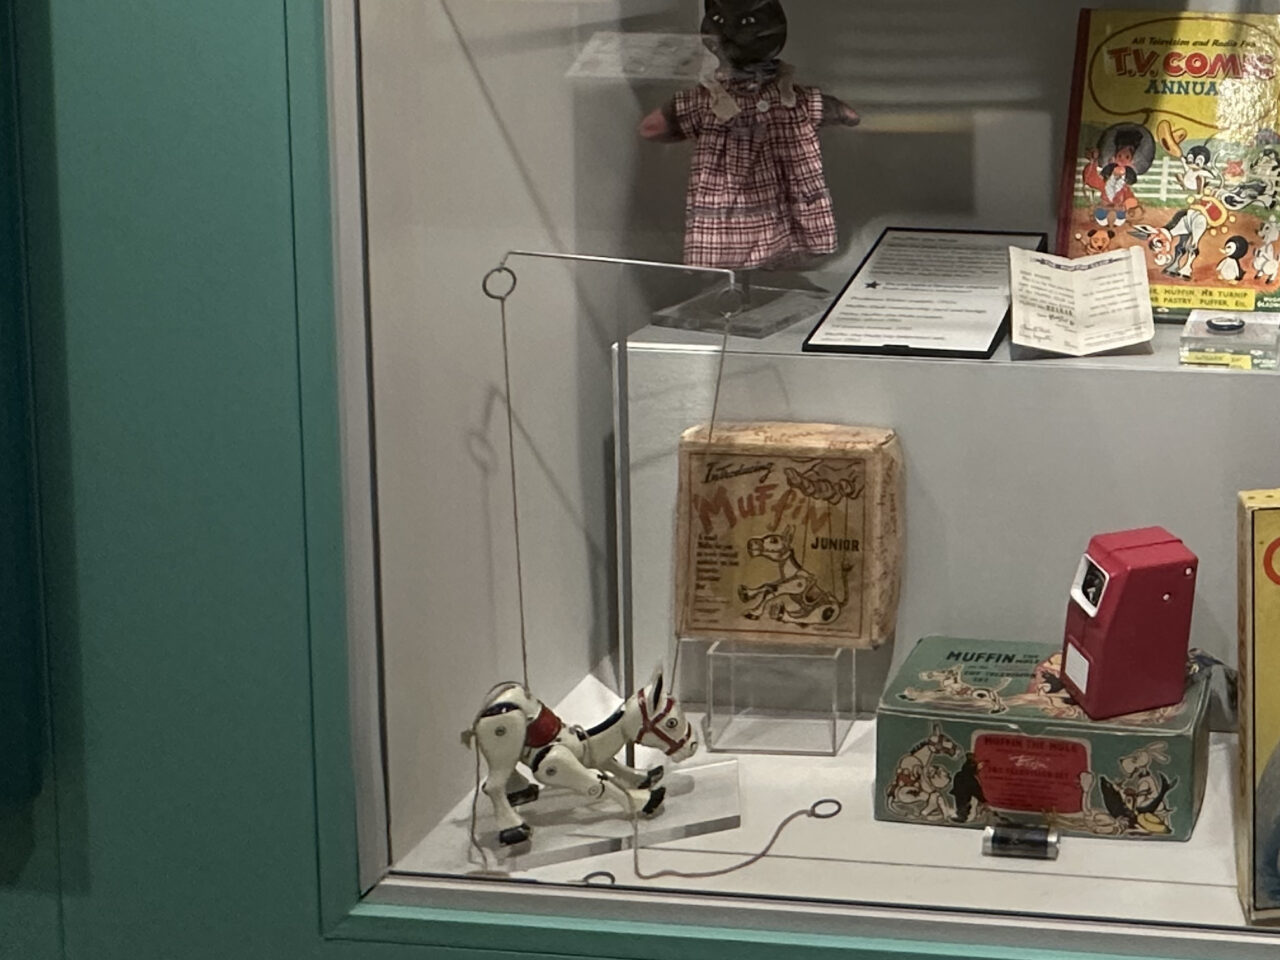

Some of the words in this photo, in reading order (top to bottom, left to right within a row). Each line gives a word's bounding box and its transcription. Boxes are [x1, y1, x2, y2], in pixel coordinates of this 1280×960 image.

[1148, 38, 1190, 46] Television
[1107, 46, 1160, 78] T.V.
[1144, 80, 1230, 96] ANNUA
[1164, 288, 1195, 296] MUFFIN,
[1201, 289, 1214, 297] MR
[1217, 290, 1248, 298] TURNIP
[1200, 298, 1229, 306] PUFFER,
[703, 461, 775, 484] Introducing
[811, 536, 860, 552] JUNIOR
[946, 650, 1016, 664] MUFFIN
[984, 736, 1022, 746] MUFFIN
[1024, 740, 1046, 749] THE
[1049, 742, 1078, 752] MULE
